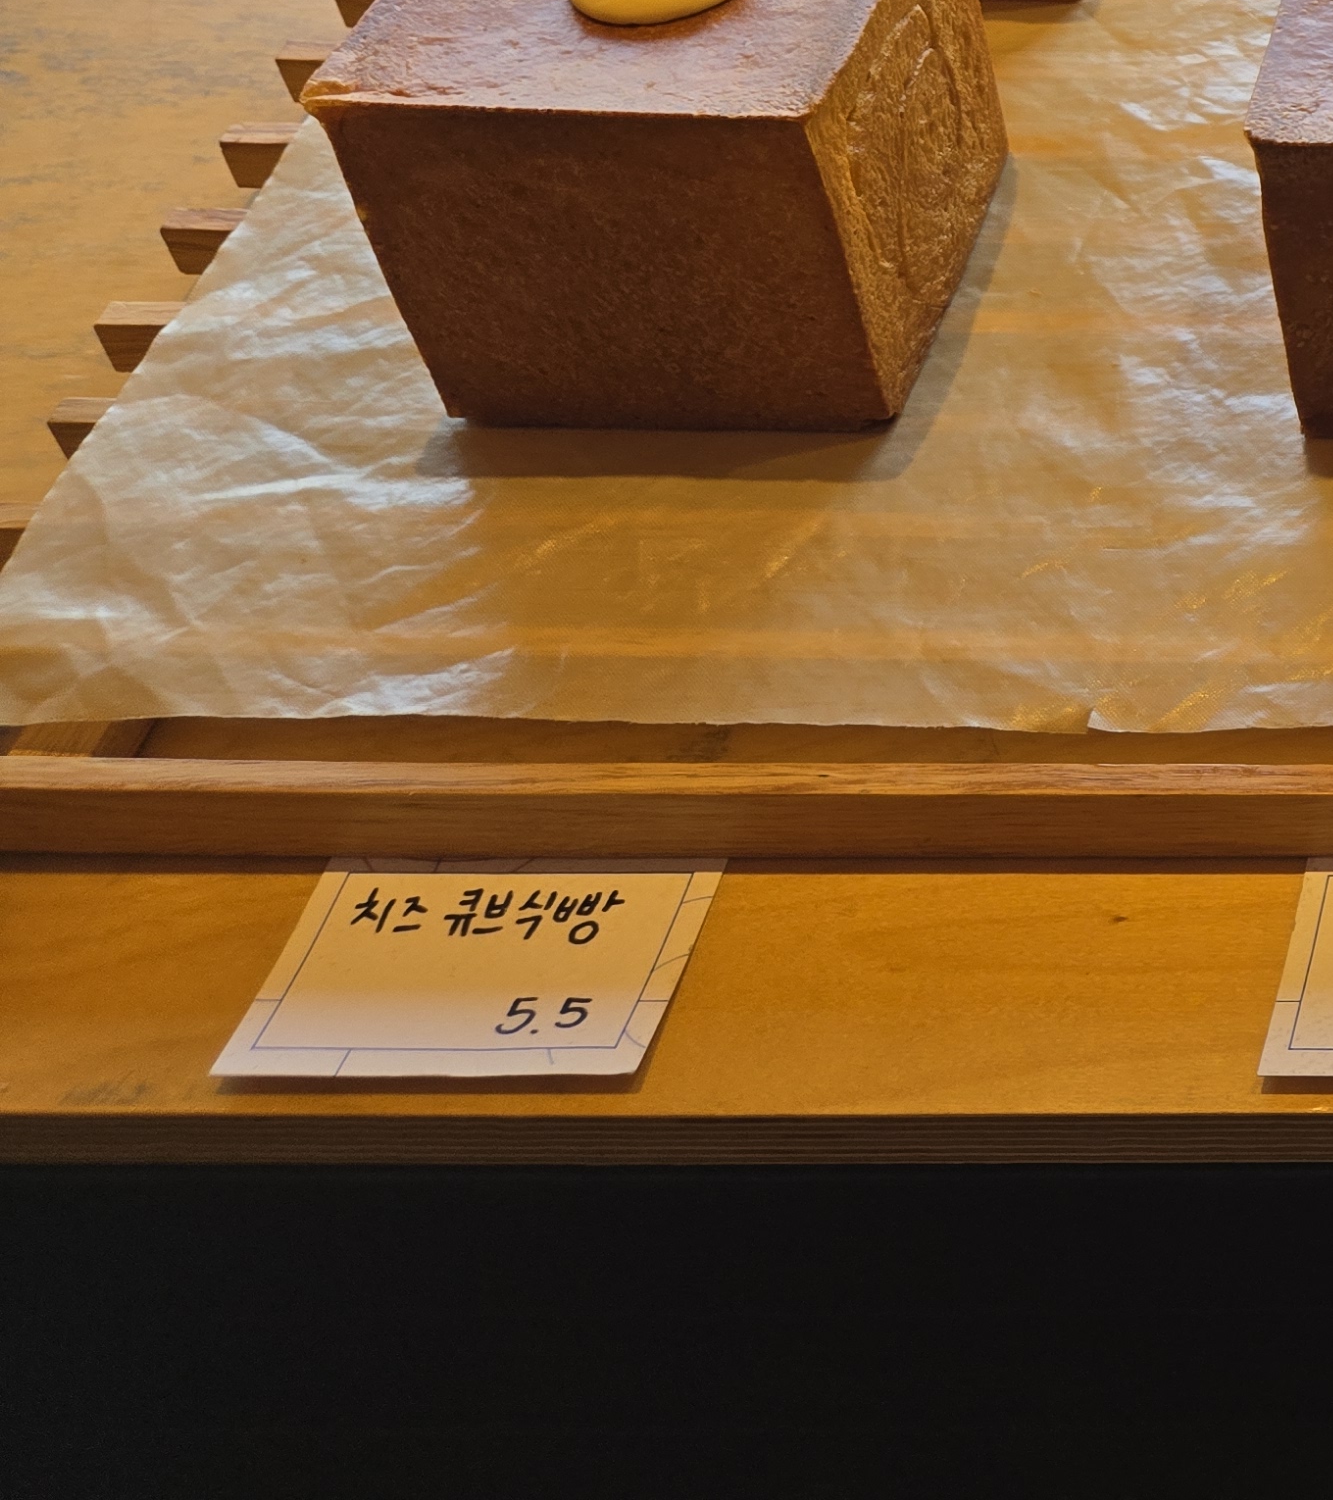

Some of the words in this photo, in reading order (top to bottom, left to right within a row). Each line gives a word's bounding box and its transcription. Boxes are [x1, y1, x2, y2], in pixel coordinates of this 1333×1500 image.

[351, 887, 428, 933] 치즈
[444, 888, 625, 945] 큐브식빵
[494, 996, 593, 1034] 5.5
